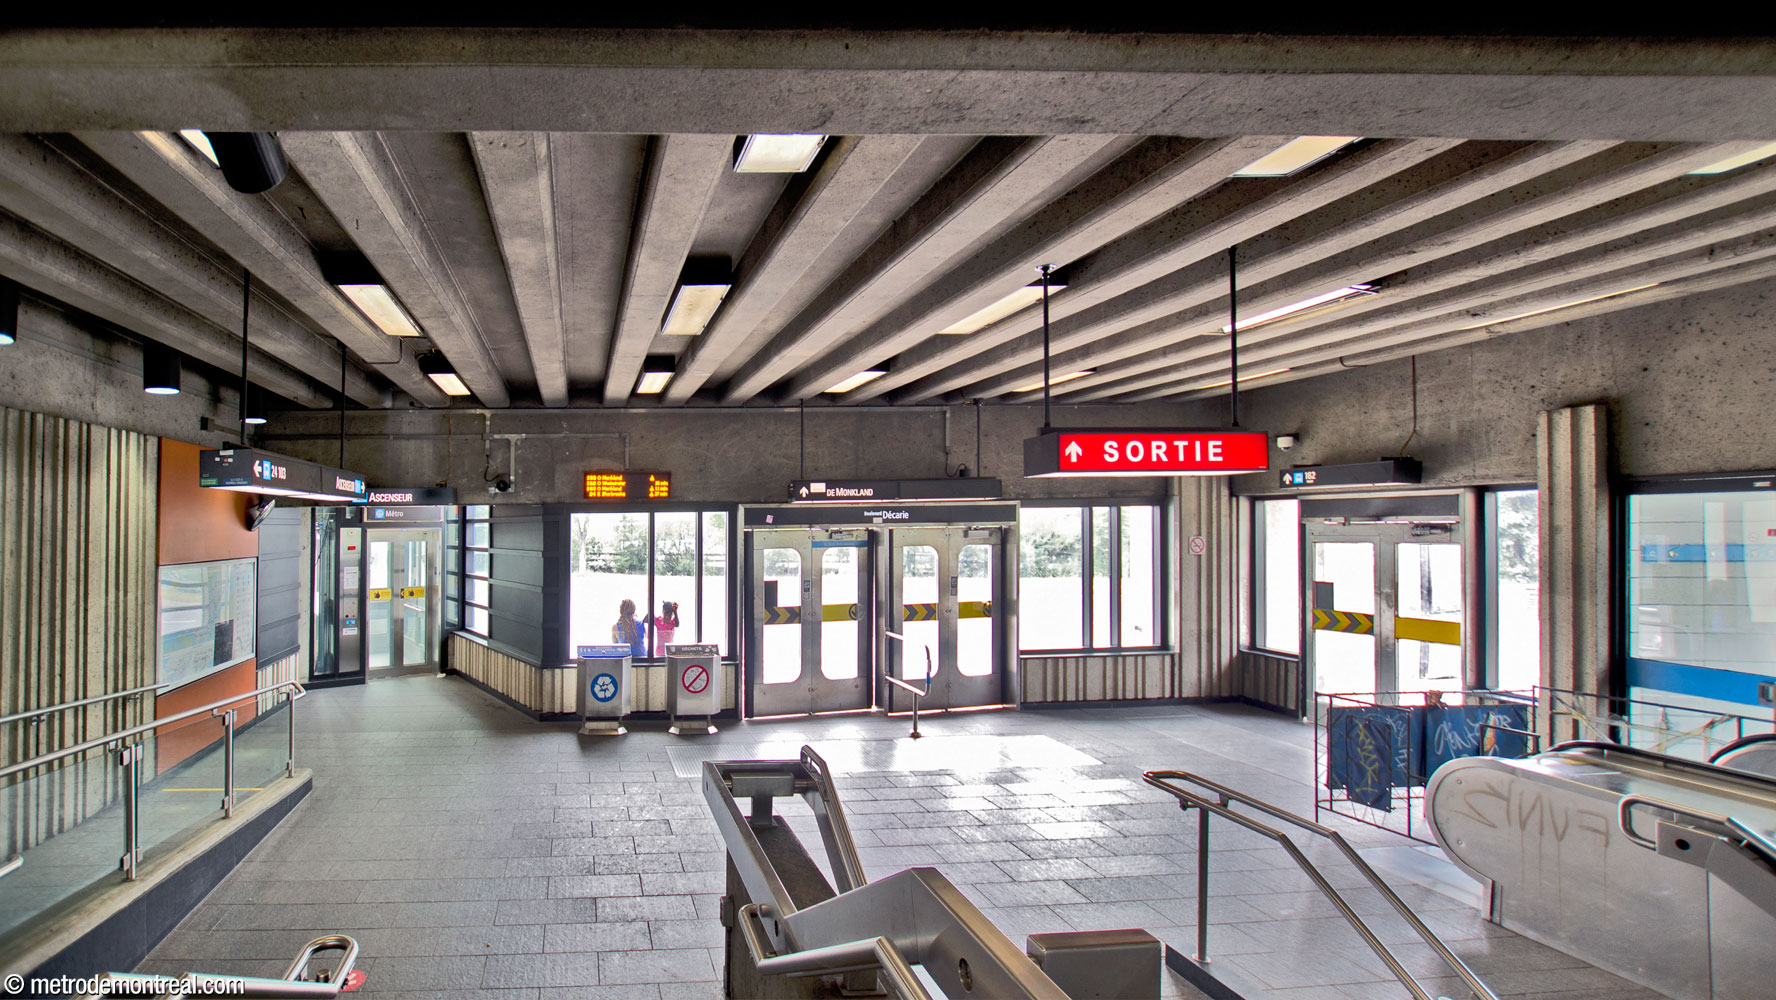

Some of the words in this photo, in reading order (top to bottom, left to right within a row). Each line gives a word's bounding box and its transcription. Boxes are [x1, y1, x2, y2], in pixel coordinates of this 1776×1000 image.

[1103, 440, 1224, 463] SORTIE
[271, 464, 278, 478] 24
[835, 487, 874, 497] MONKLAND
[368, 492, 413, 503] ASCENSEUR
[385, 509, 404, 518] Métro
[882, 510, 909, 519] Décarie
